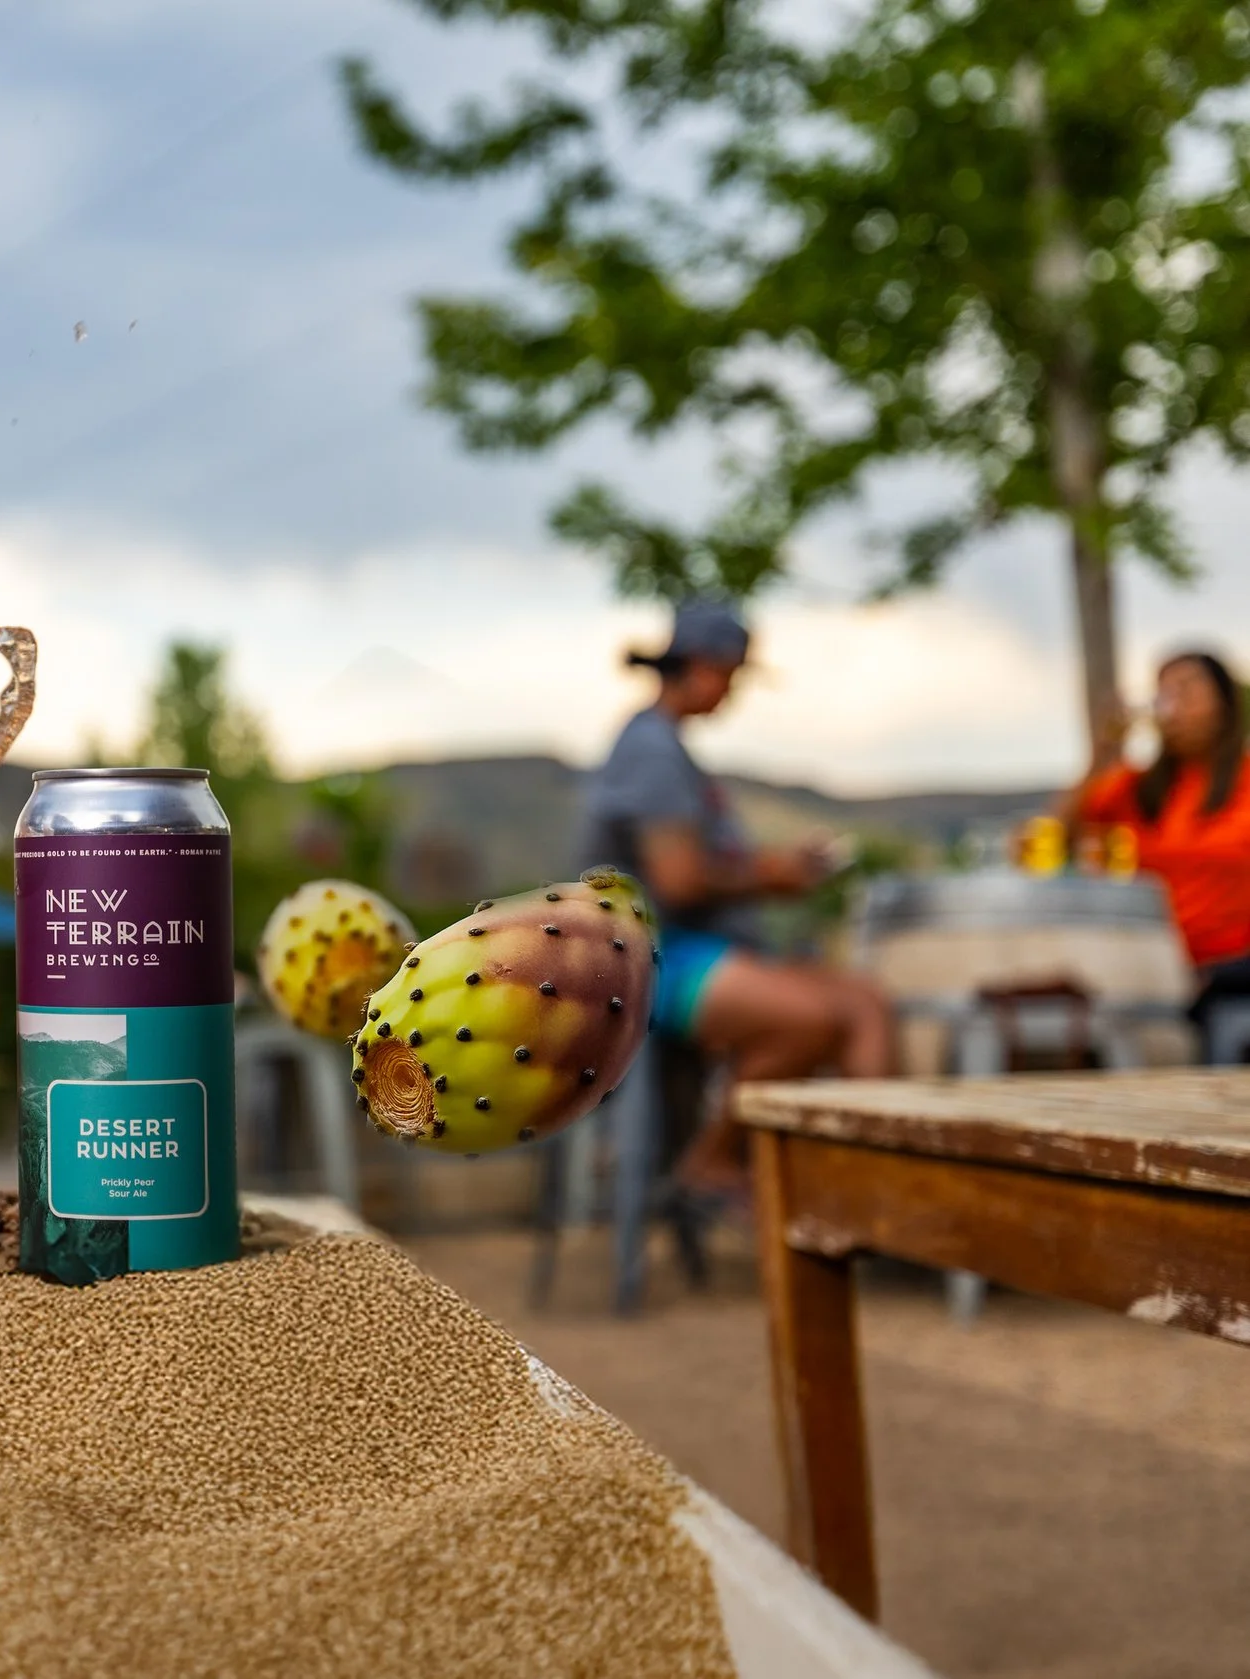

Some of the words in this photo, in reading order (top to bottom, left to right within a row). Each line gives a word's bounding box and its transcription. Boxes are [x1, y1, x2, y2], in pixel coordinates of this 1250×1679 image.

[46, 889, 128, 913] NEW
[46, 920, 204, 945] TERRAIN
[46, 954, 140, 966] BREWING
[79, 1118, 176, 1137] DESERT
[77, 1140, 179, 1159] RUNNER
[101, 1178, 131, 1188] Prickly
[134, 1178, 155, 1186] Pear
[109, 1189, 130, 1198] Sour
[133, 1189, 148, 1198] Ale
